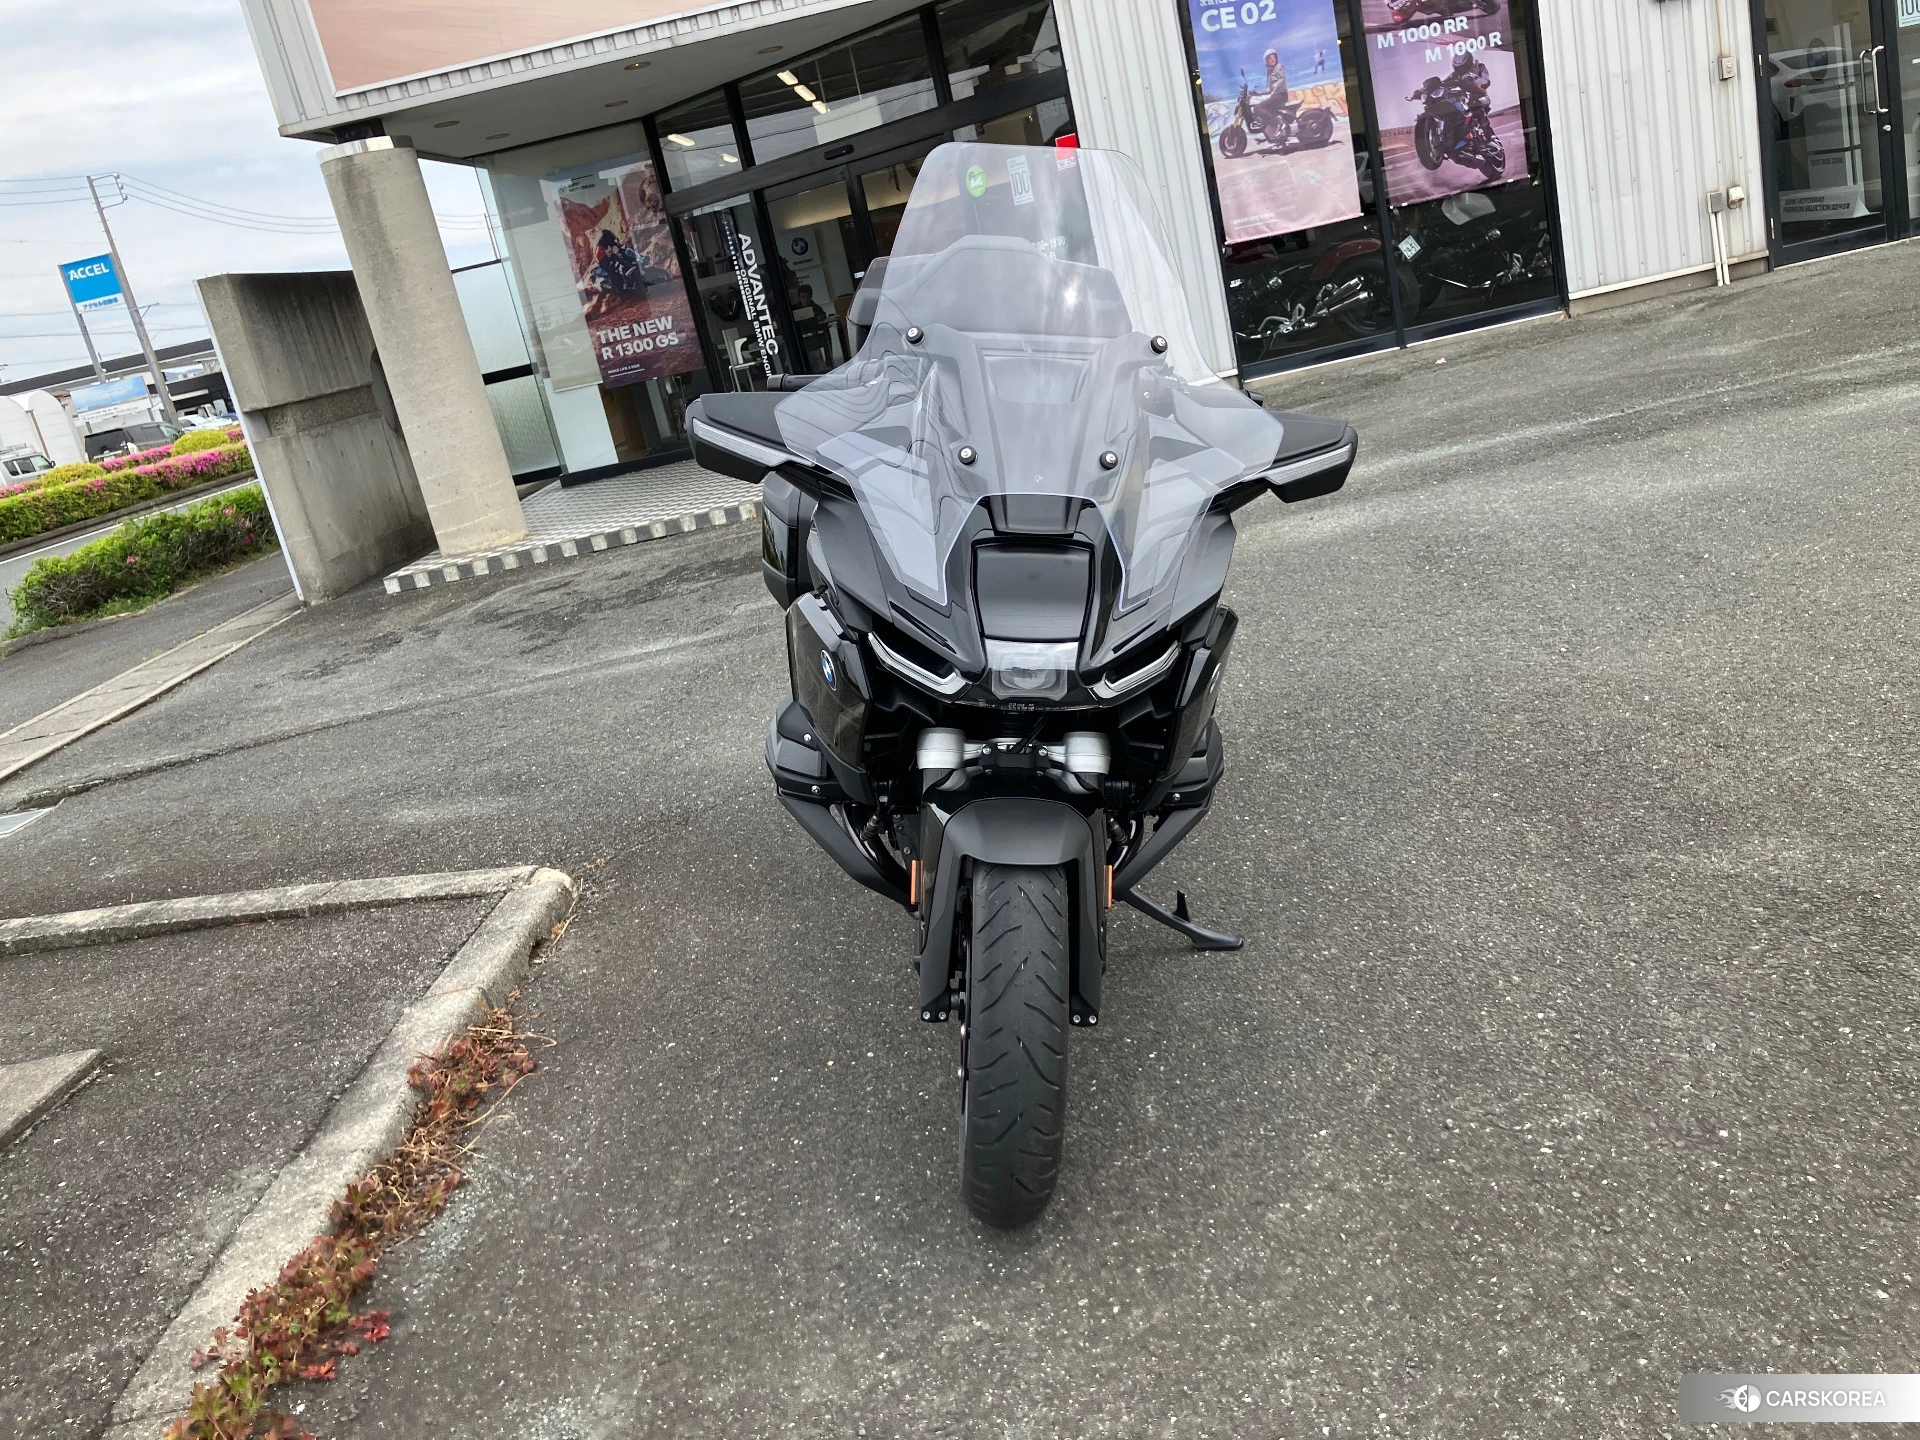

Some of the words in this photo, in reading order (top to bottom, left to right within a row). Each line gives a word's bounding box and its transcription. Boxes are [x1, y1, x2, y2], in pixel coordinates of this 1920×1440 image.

[1201, 6, 1237, 32] CE
[1240, 0, 1277, 25] 02
[1376, 33, 1395, 49] M
[1398, 22, 1441, 44] 1000
[1443, 16, 1469, 34] RR
[1425, 47, 1442, 63] M
[1446, 35, 1486, 58] 1000
[1488, 31, 1502, 47] R
[1010, 170, 1031, 197] 100
[68, 262, 110, 281] ACCEL
[738, 233, 779, 356] ADVANTEC
[740, 269, 757, 320] ORIGINAL
[753, 321, 765, 347] BMW
[597, 325, 632, 344] THE
[632, 315, 673, 336] NEW
[601, 346, 614, 360] R
[615, 337, 654, 357] 1300
[655, 332, 679, 348] GS
